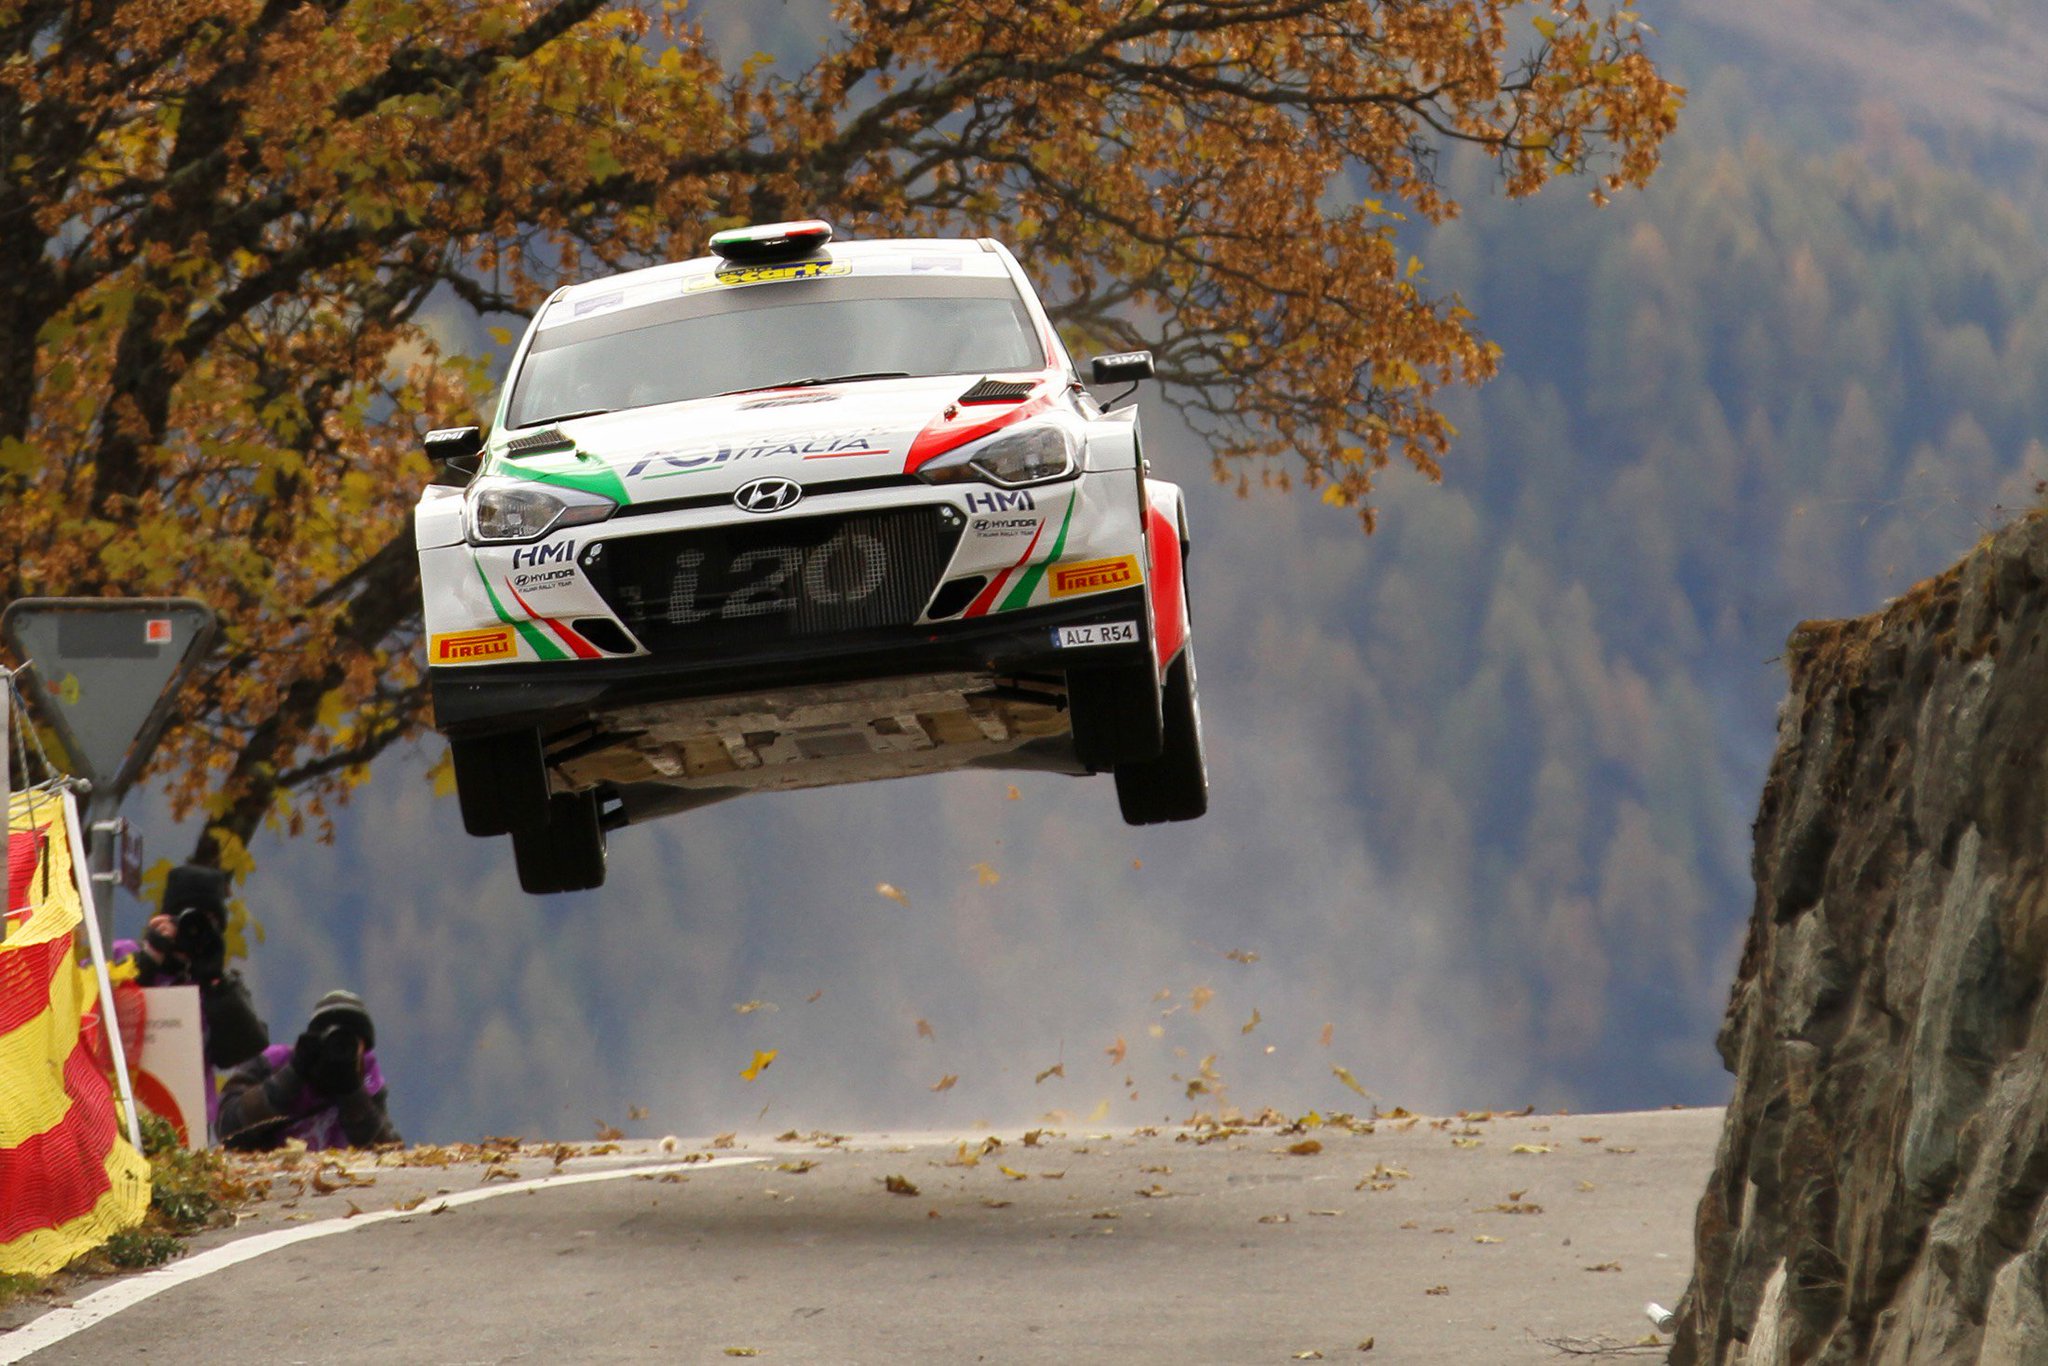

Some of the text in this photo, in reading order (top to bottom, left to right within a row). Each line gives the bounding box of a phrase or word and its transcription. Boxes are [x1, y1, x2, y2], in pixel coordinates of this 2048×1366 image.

[733, 437, 870, 460] ITALIA
[965, 490, 1035, 513] HMI
[992, 518, 1037, 528] HYUNDAI
[513, 539, 575, 570] HMI
[530, 569, 574, 581] HYUNDAI
[1057, 562, 1131, 591] PIRELLI
[440, 632, 509, 659] PIRELLI
[1067, 625, 1132, 645] ALZ R54
